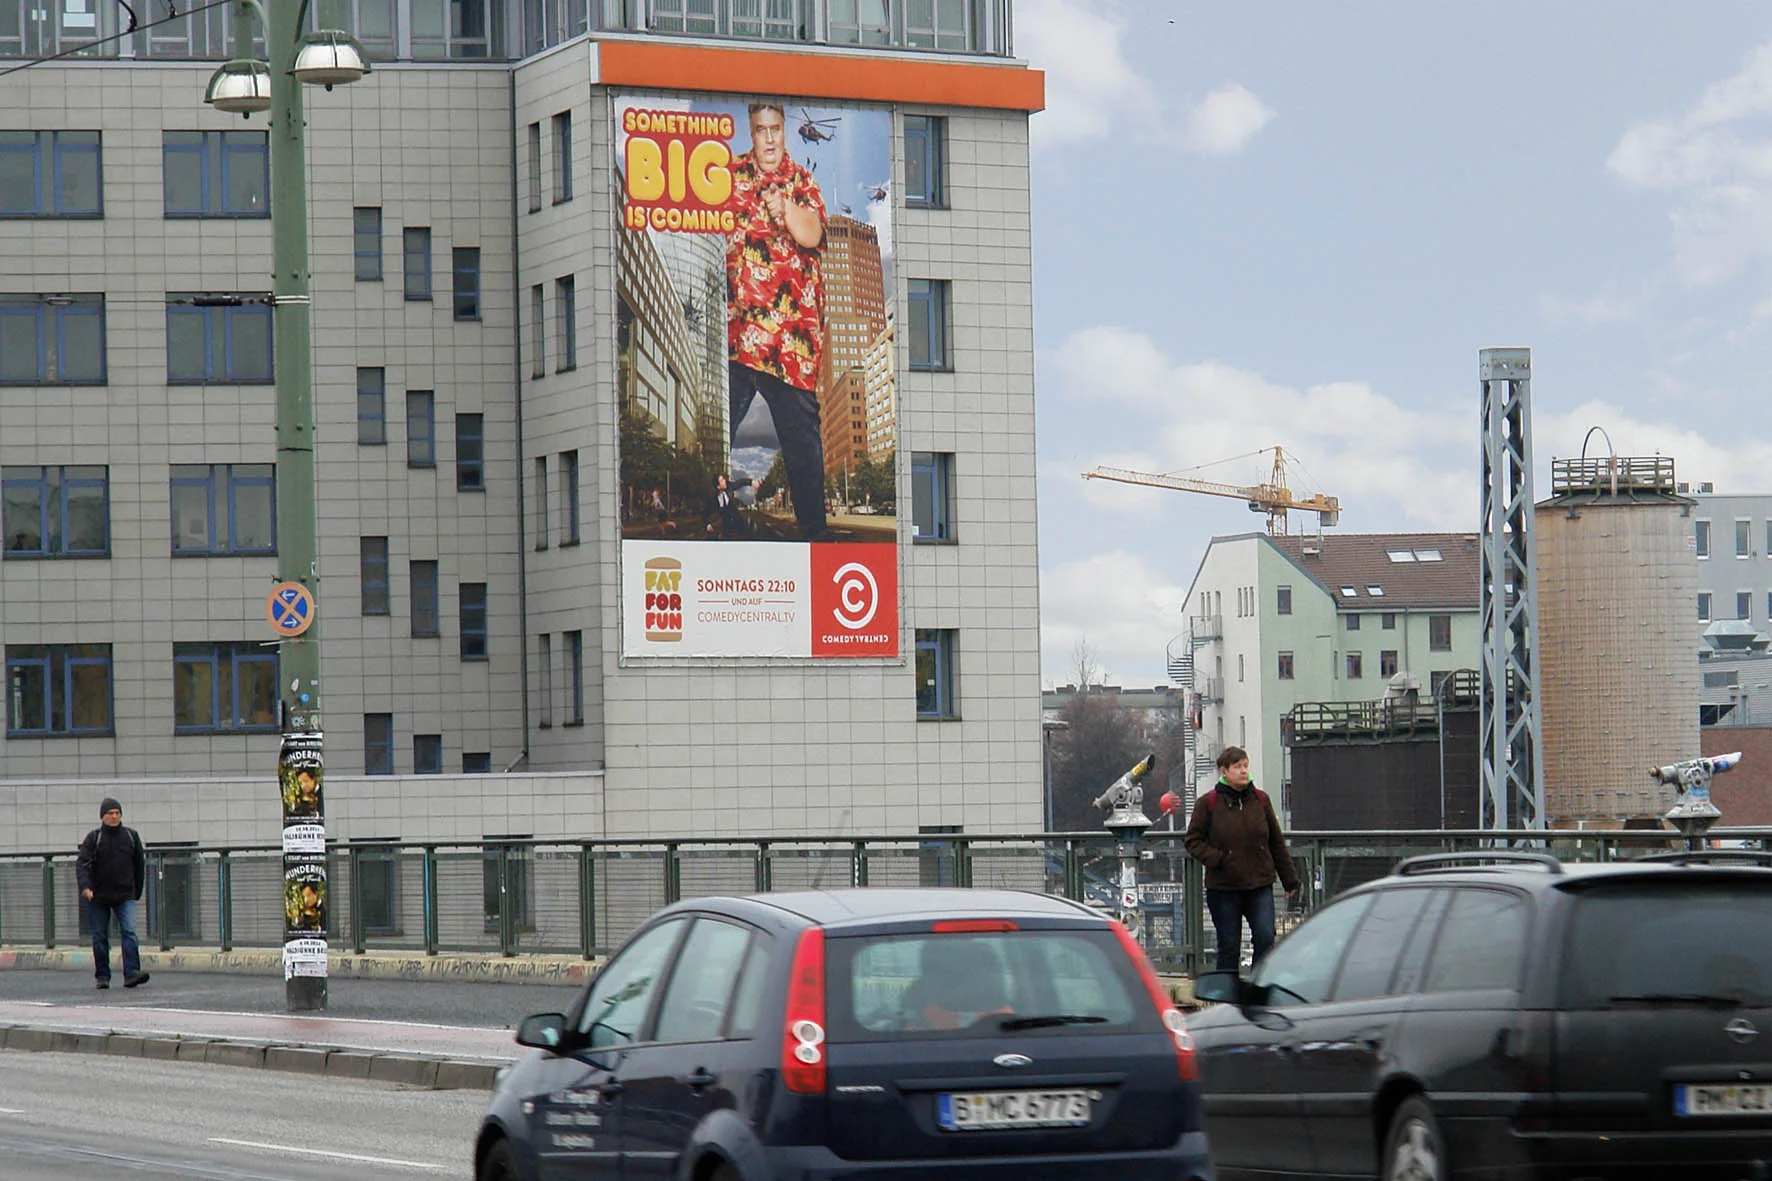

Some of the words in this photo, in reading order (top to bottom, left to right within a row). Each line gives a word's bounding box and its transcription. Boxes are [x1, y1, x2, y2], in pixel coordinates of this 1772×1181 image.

[625, 111, 732, 137] SOMETHING
[627, 137, 732, 206] BIG
[627, 205, 646, 228] IS
[651, 207, 735, 232] COMING
[645, 571, 682, 592] FAT
[697, 579, 764, 592] SONNTAGS
[767, 580, 796, 593] 22:10
[645, 593, 682, 611] FOR
[731, 597, 748, 606] UND
[748, 598, 762, 606] AUF
[645, 612, 682, 630] FUN
[697, 611, 796, 623] COMEDYCENTRAL.TV
[822, 634, 854, 643] COMEDY
[955, 1097, 970, 1121] B
